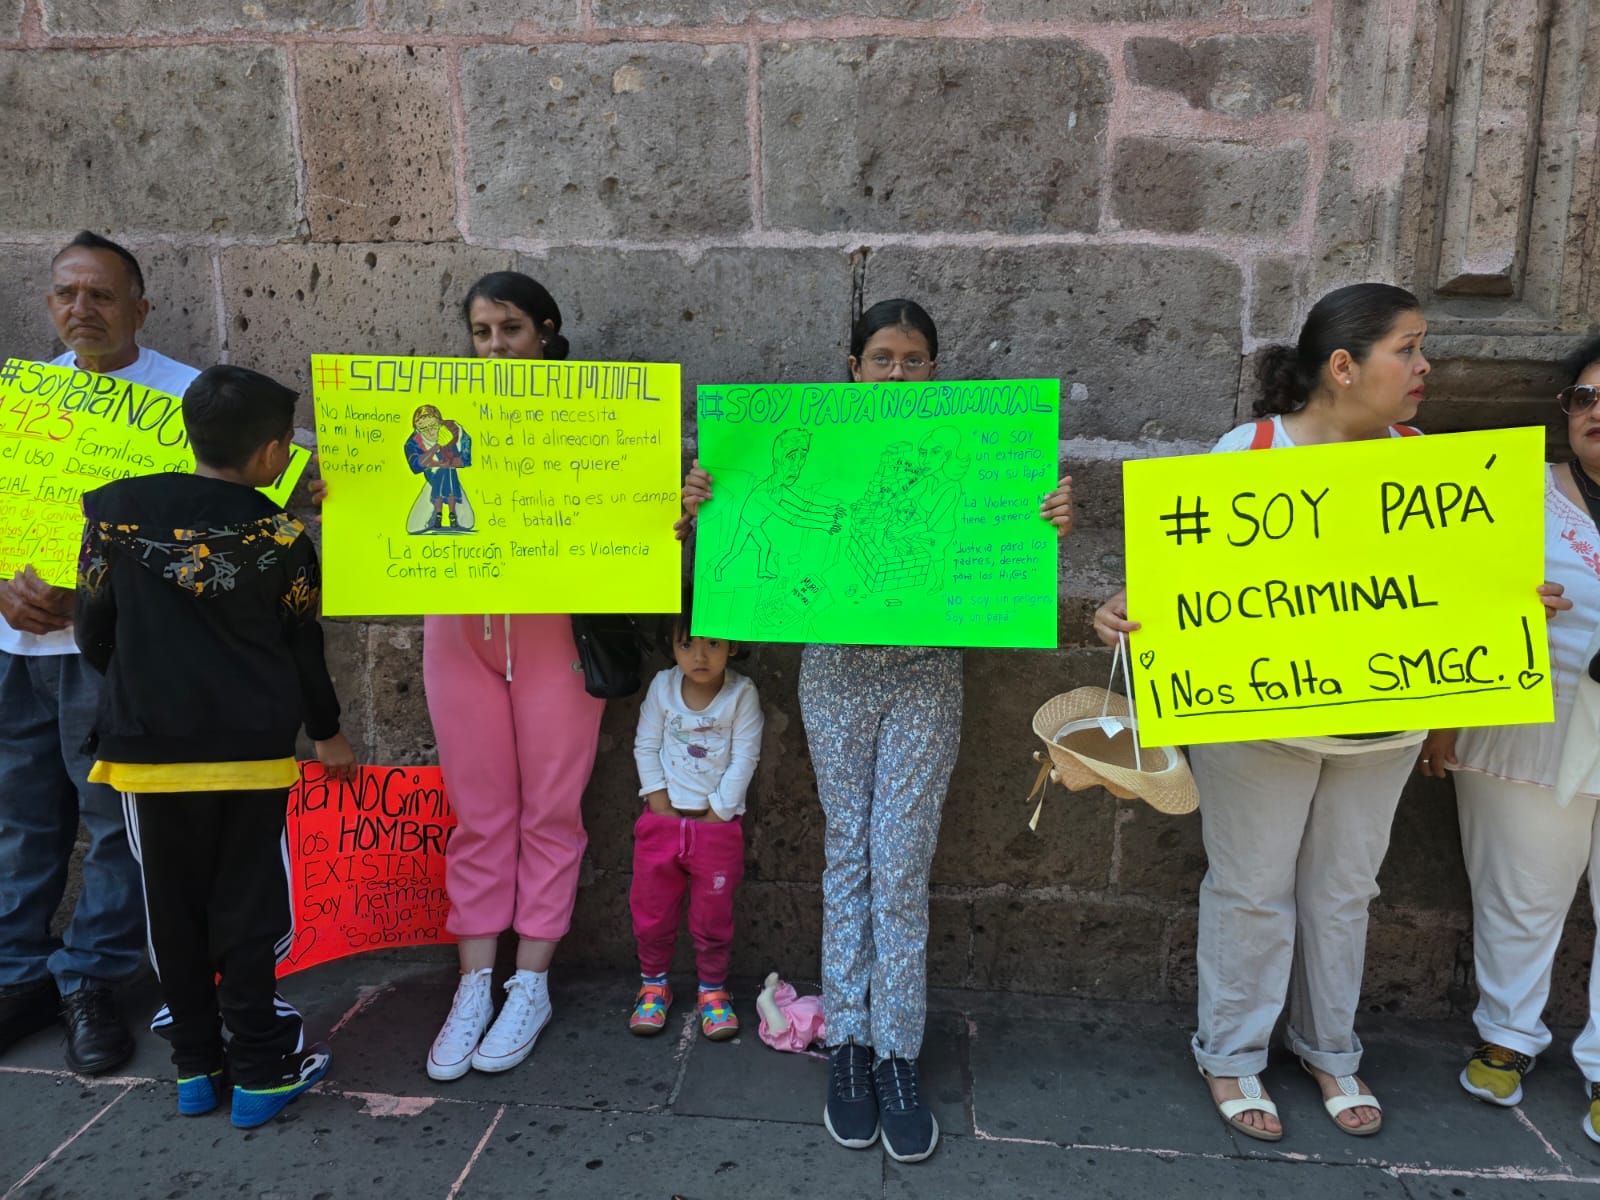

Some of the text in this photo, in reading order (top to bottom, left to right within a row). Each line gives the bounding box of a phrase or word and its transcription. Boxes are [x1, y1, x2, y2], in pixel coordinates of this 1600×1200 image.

[344, 402, 401, 424] Abandone
[525, 406, 545, 422] me
[551, 404, 618, 423] necesita
[320, 423, 327, 434] a
[334, 424, 347, 437] mi
[480, 430, 501, 448] No
[505, 434, 515, 447] a
[523, 428, 536, 447] la
[616, 428, 662, 448] Parental
[3, 440, 22, 459] el
[75, 428, 155, 468] familias
[321, 443, 360, 458] me lo
[481, 454, 499, 472] Mi
[543, 459, 563, 473] me
[511, 488, 556, 513] familia
[563, 492, 582, 507] no
[584, 493, 605, 506] es
[610, 492, 628, 505] un
[632, 490, 679, 506] campo
[1380, 454, 1497, 534] PAPÁ
[487, 511, 508, 529] de
[510, 540, 560, 558] Parental
[568, 546, 587, 557] es
[590, 540, 650, 558] Violencia
[386, 560, 438, 579] Contra
[444, 560, 458, 579] el
[1177, 574, 1440, 631] NOCRIMINAL
[1248, 656, 1343, 702] falta
[304, 853, 431, 891] EXISTEN
[302, 894, 342, 923] Soy
